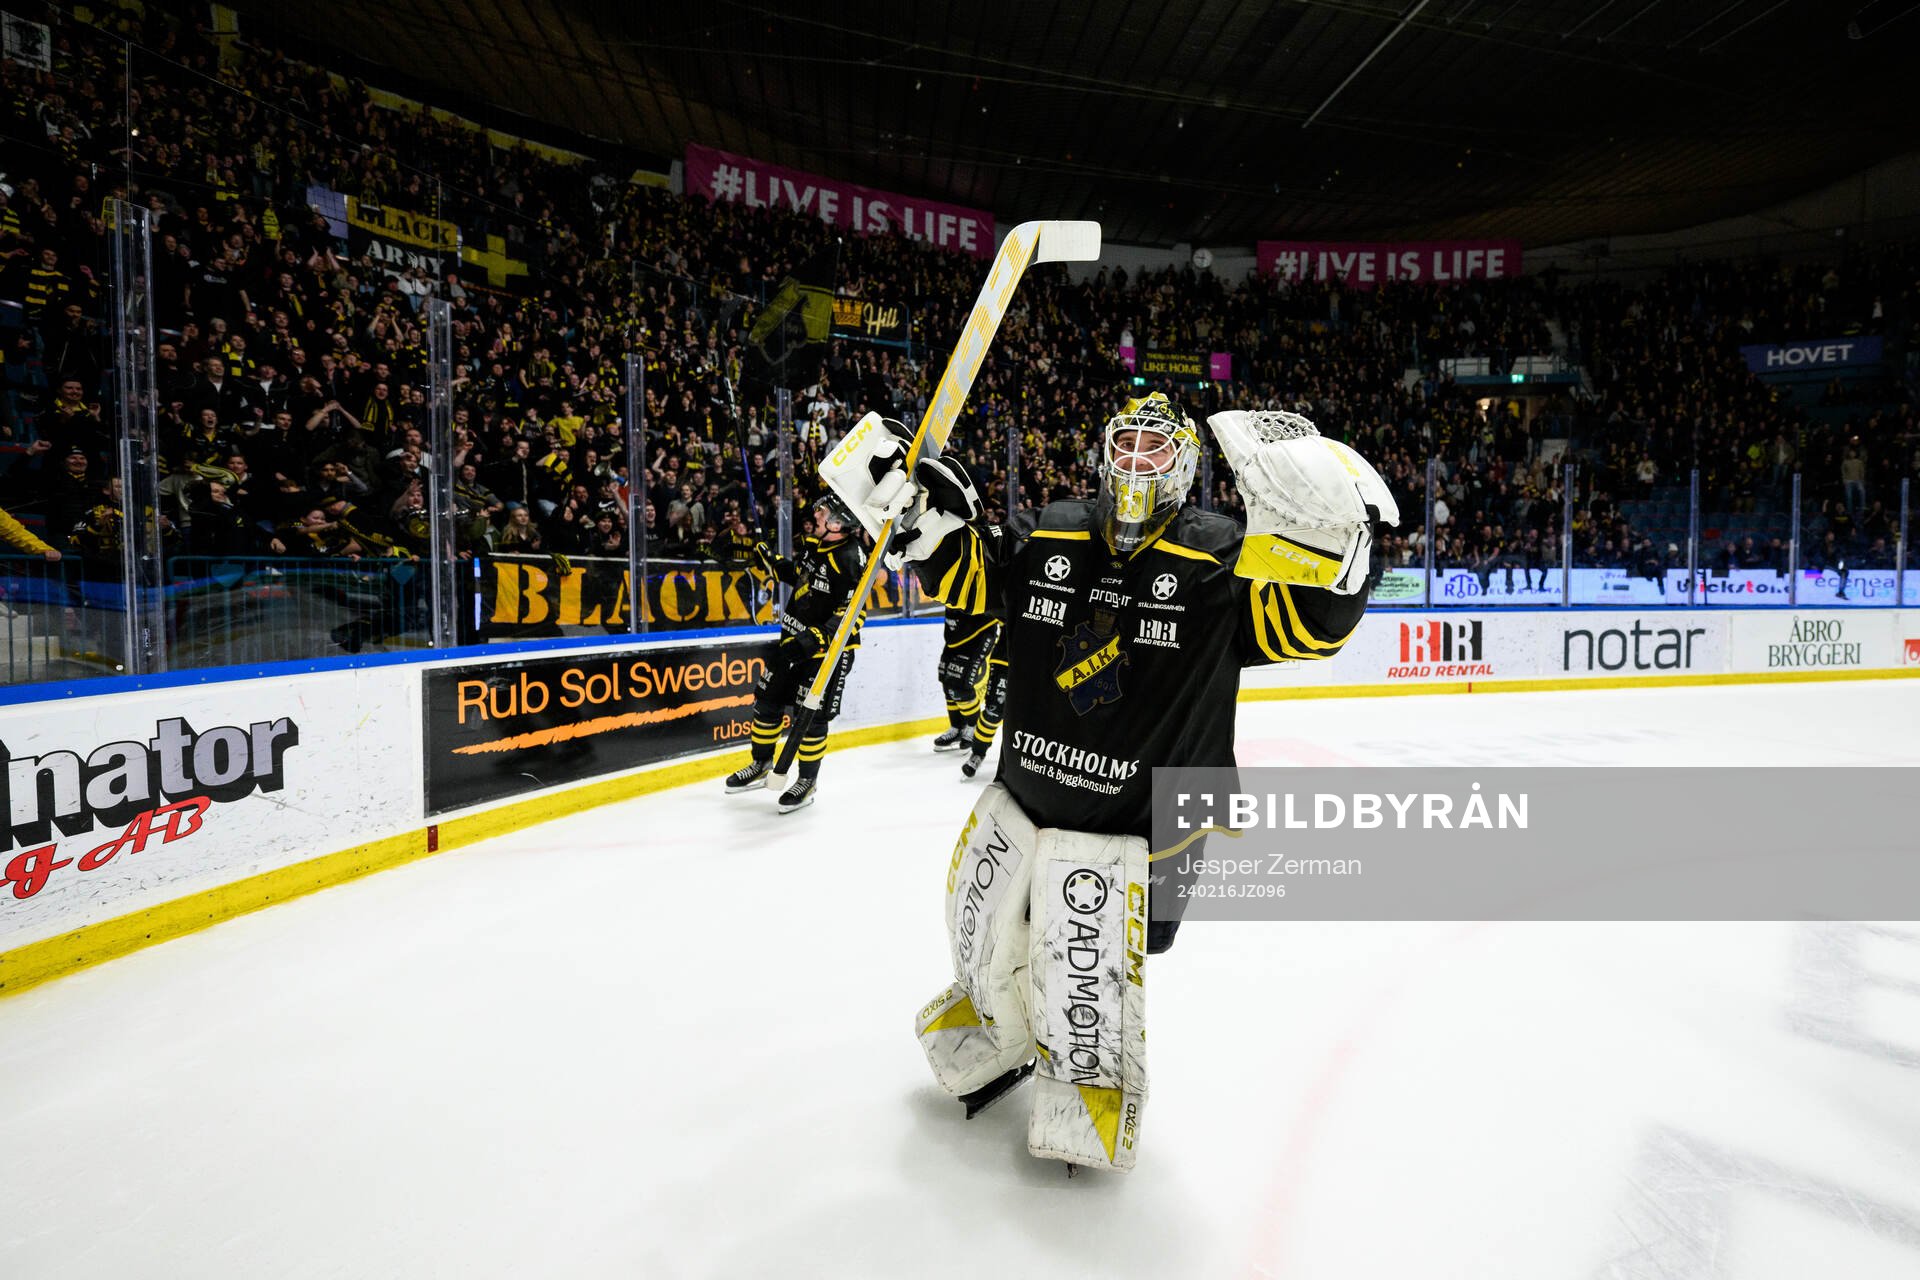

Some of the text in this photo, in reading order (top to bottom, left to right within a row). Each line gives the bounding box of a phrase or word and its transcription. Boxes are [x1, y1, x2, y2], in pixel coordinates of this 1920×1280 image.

[710, 164, 977, 251] #LIVE IS LIFE
[1387, 251, 1421, 281] IS
[1433, 249, 1504, 279] LIFE
[863, 303, 900, 336] Hill
[1143, 361, 1167, 373] LIKE
[1169, 362, 1202, 374] HOME
[1766, 344, 1854, 366] HOVET
[832, 420, 873, 467] CCM
[1115, 535, 1146, 544] CCM
[1271, 543, 1321, 569] CCM
[490, 562, 750, 625] BLACK
[1101, 577, 1123, 585] CCM
[1563, 619, 1706, 672] notar
[1789, 616, 1842, 642] ÅBRO
[1387, 665, 1495, 678] ROAD RENTAL
[1768, 643, 1862, 667] BRYGGERI
[457, 671, 550, 724] Rub
[559, 662, 622, 708] Sol
[629, 653, 766, 695] Sweden
[5, 716, 298, 842] nator
[1012, 730, 1140, 781] STOCKHOLMS
[1020, 756, 1047, 775] Måleri
[1047, 766, 1055, 778] &
[77, 795, 211, 871] AB
[946, 810, 978, 895] CCM
[959, 829, 1010, 966] MOTION
[1127, 882, 1145, 988] CCM
[1067, 918, 1101, 1088] ADMOTION
